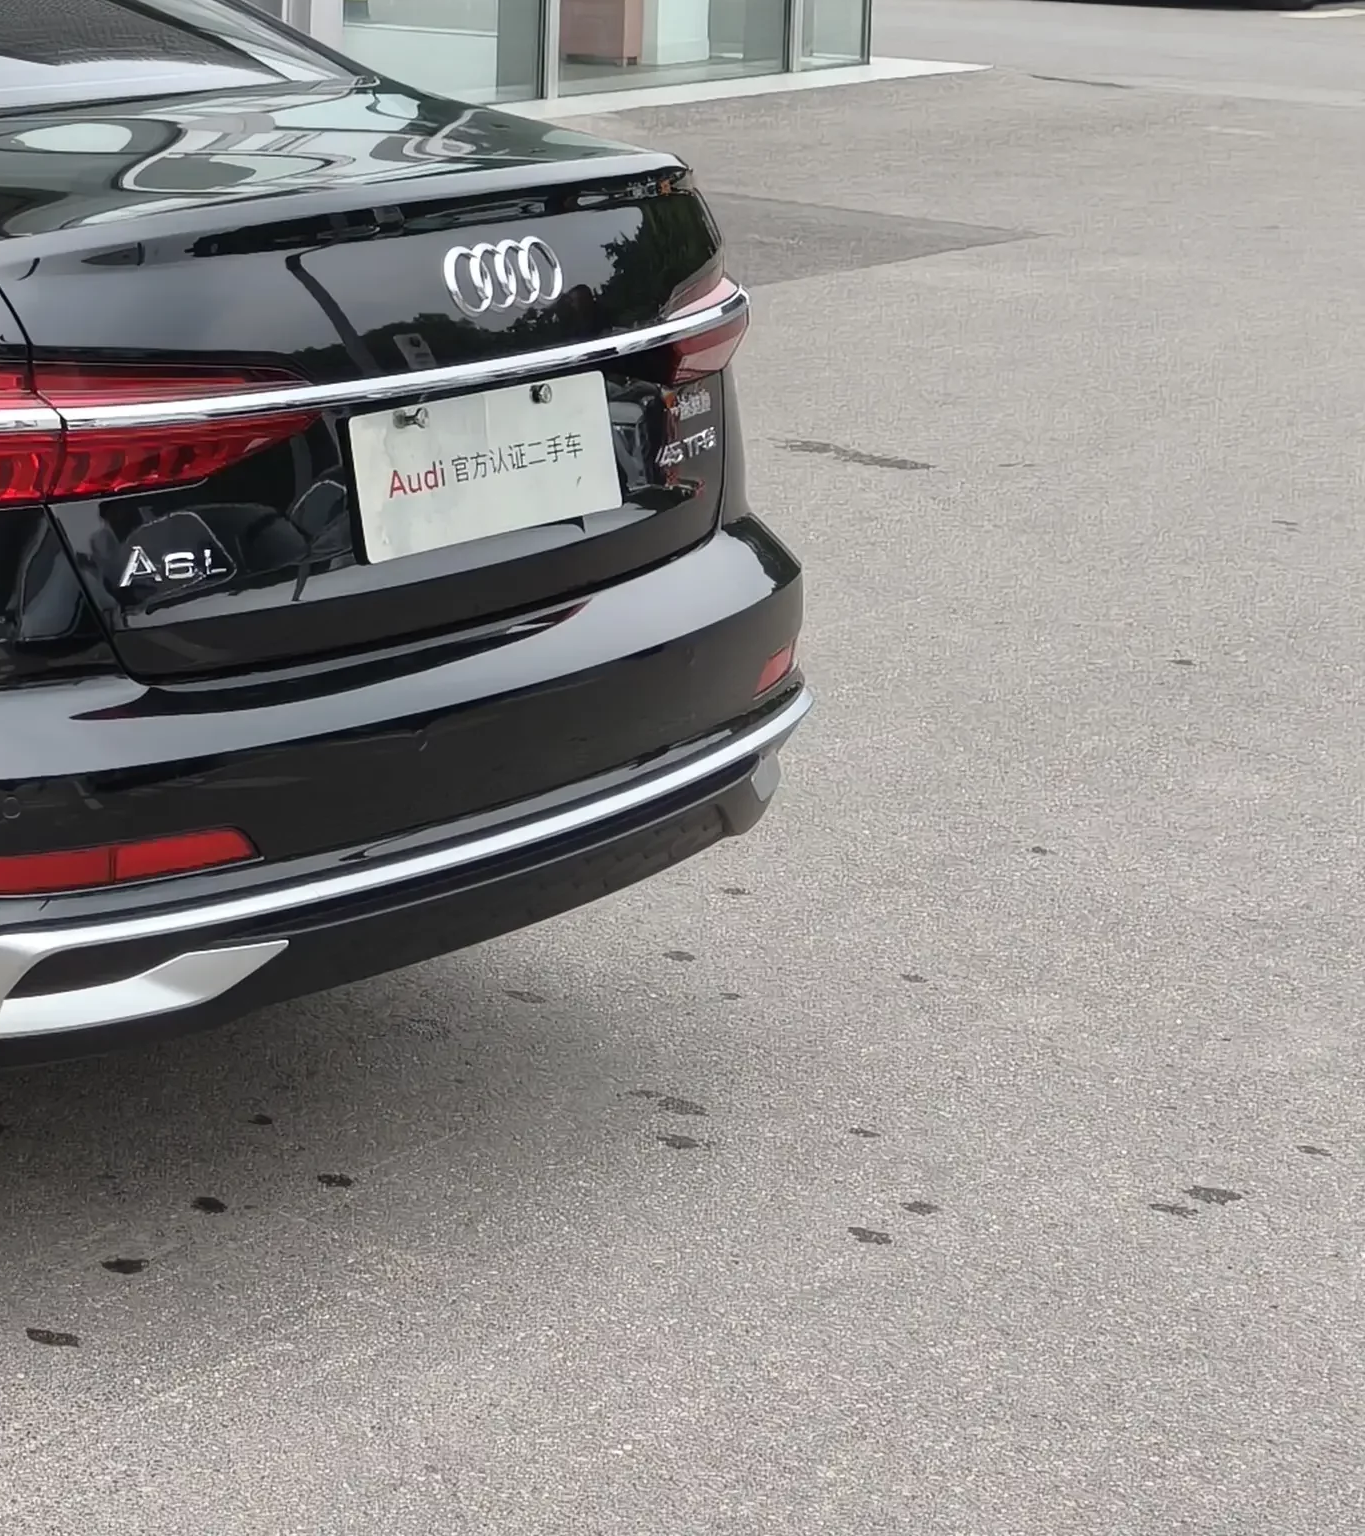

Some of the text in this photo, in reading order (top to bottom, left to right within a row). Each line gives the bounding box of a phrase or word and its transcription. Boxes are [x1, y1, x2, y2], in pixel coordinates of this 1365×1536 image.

[389, 432, 584, 498] Audi 官方认证二手车
[119, 545, 228, 587] A6L
